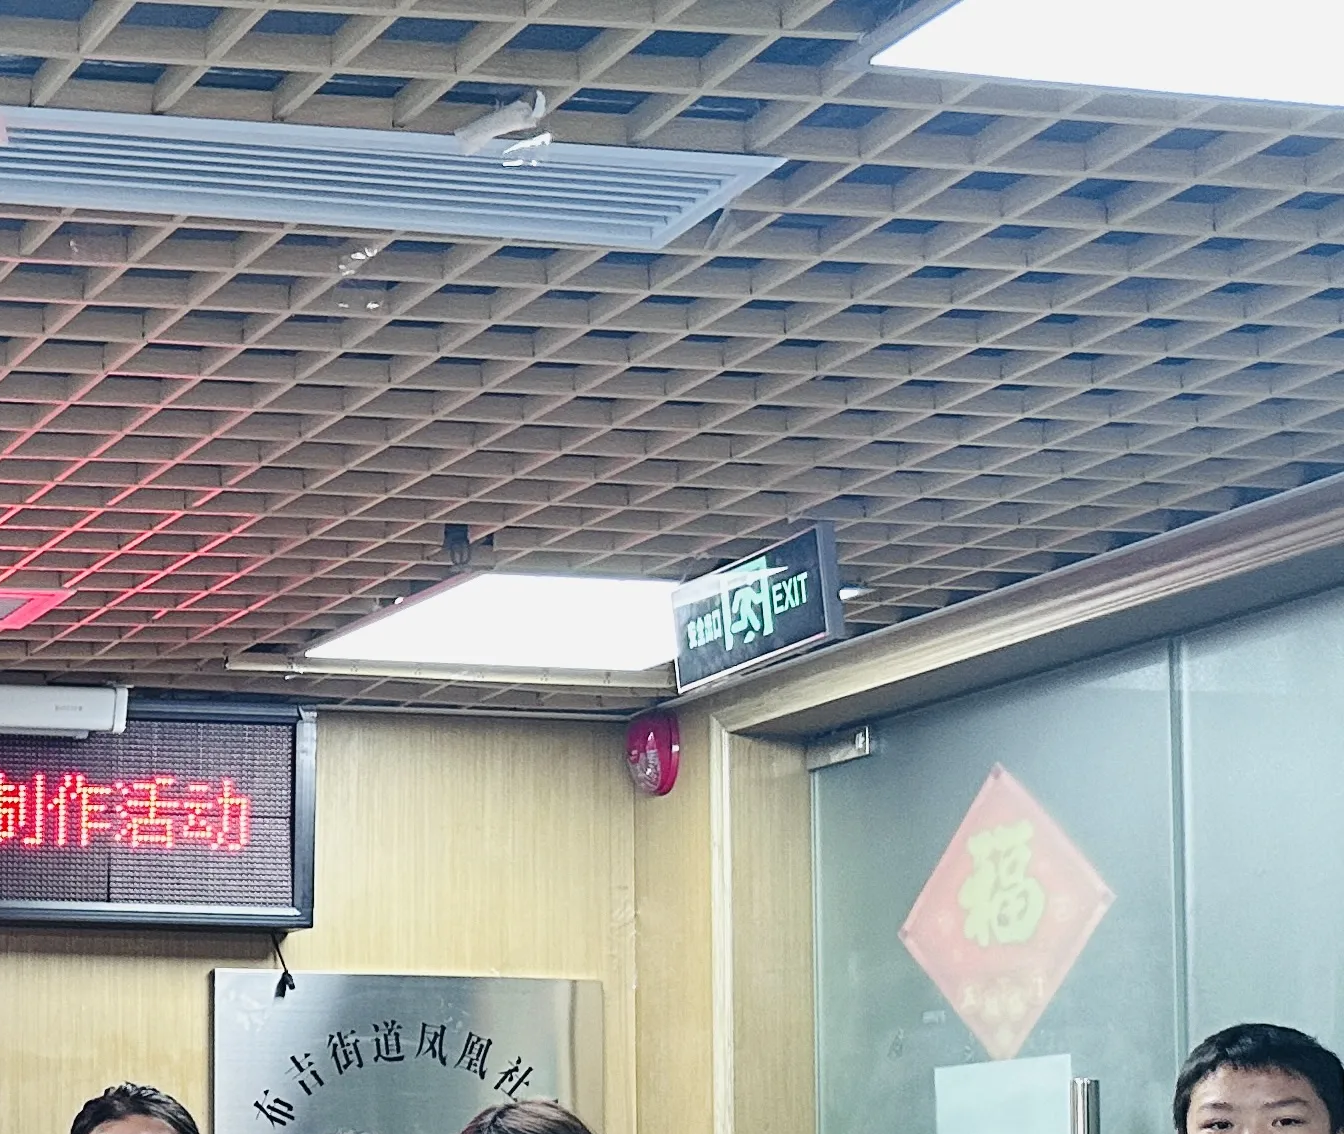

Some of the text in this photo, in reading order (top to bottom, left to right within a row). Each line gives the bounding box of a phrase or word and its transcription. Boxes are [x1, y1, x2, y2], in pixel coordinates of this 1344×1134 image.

[772, 571, 808, 615] EXIT
[958, 819, 1045, 947] 福
[252, 1019, 560, 1128] 布吉街道凤凰社
